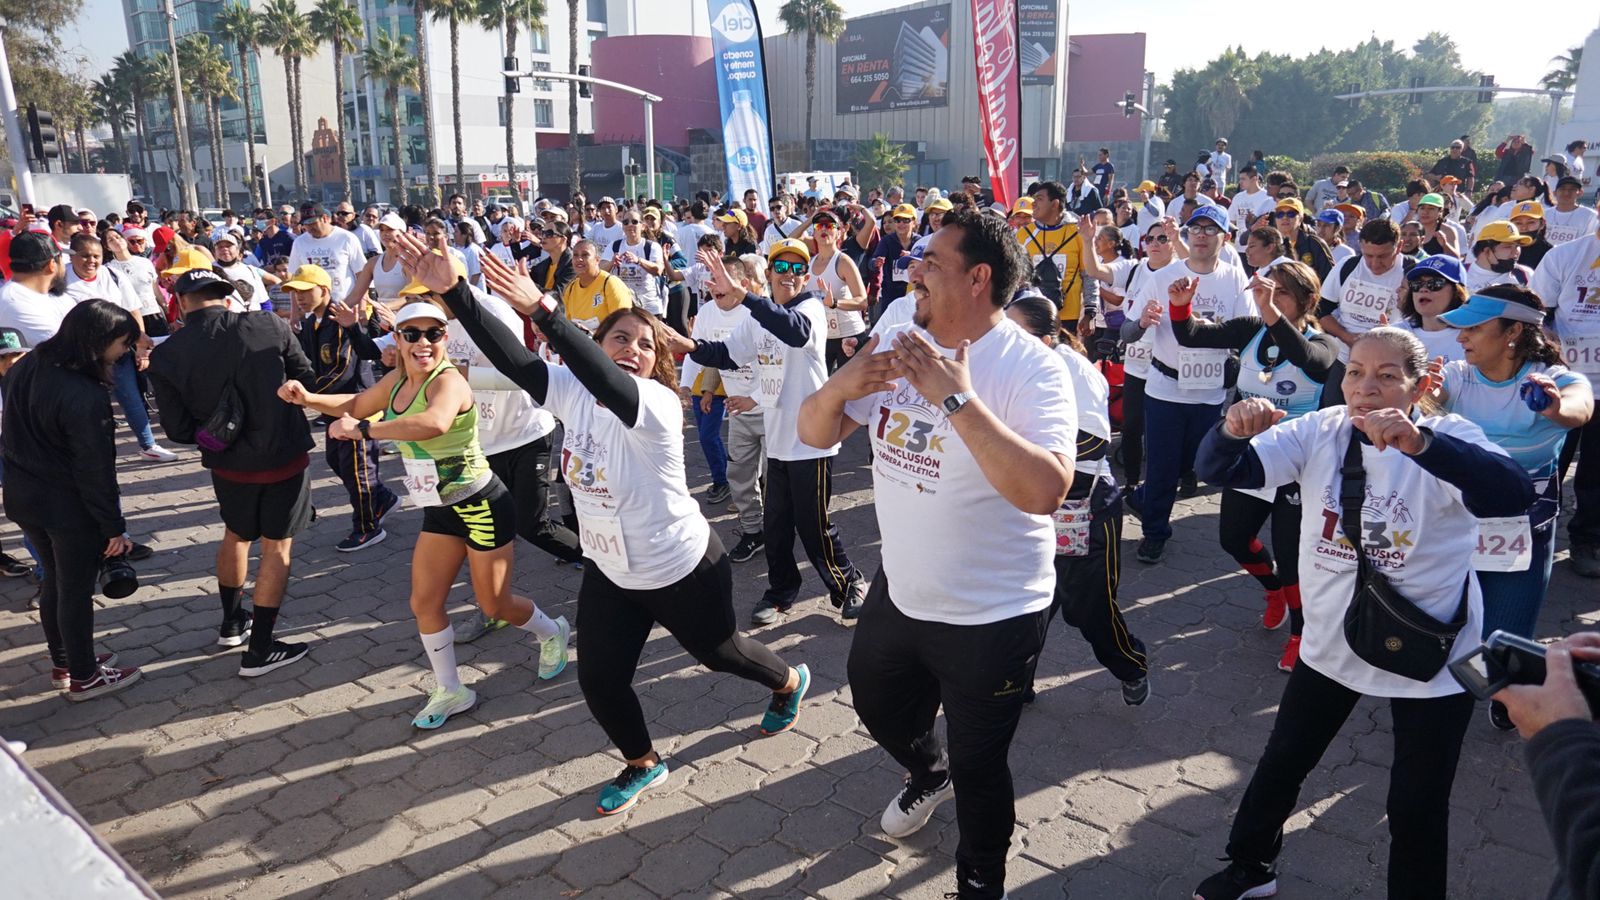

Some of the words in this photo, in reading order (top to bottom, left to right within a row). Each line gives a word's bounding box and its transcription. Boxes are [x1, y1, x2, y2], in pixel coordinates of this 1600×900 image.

[841, 53, 867, 62] OFICINAS
[841, 63, 855, 74] EN
[856, 59, 889, 73] RENTA
[850, 76, 862, 84] 664
[863, 74, 873, 82] 215
[874, 72, 890, 81] 5050
[1345, 289, 1387, 311] 0205
[1181, 363, 1223, 379] 0009
[886, 443, 941, 469] INCLUSIÓN
[902, 461, 940, 479] ATLÉTICA
[452, 499, 497, 548] NIKE
[1316, 546, 1357, 561] CARRER
